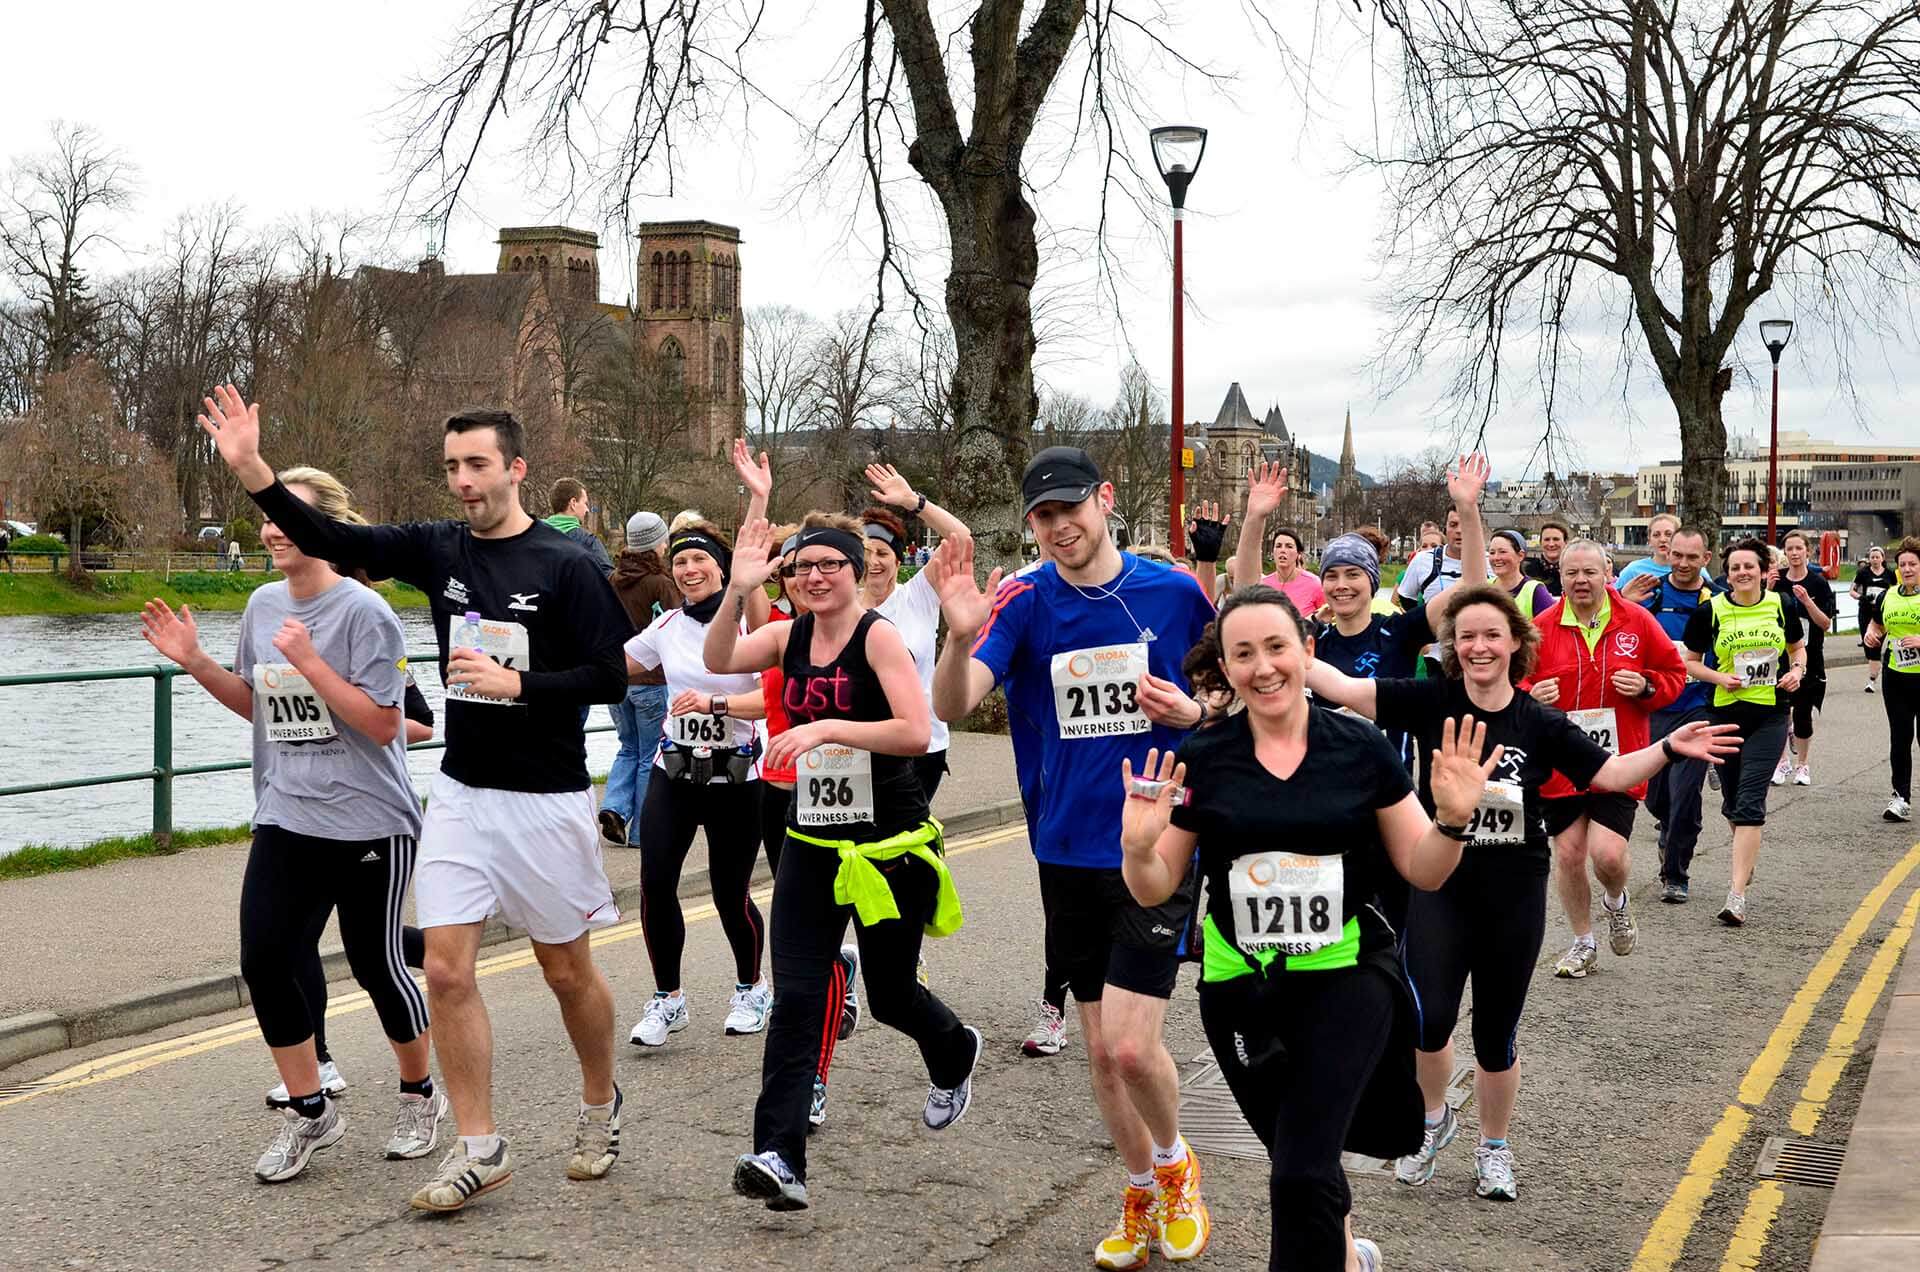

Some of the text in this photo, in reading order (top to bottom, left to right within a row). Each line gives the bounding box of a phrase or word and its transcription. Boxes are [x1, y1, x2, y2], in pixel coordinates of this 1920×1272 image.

[1720, 628, 1781, 649] MUIR of ORD
[1093, 649, 1130, 662] GLOBAL
[1745, 662, 1771, 681] 940
[268, 694, 321, 724] 2105
[1066, 681, 1140, 719] 2133
[269, 726, 315, 739] INVERNESS
[678, 718, 726, 742] 1963
[1063, 718, 1149, 737] INVERNESS 1/2
[809, 777, 854, 807] 936
[798, 810, 869, 824] INVERNESS 1/2
[1246, 894, 1331, 934] 1218
